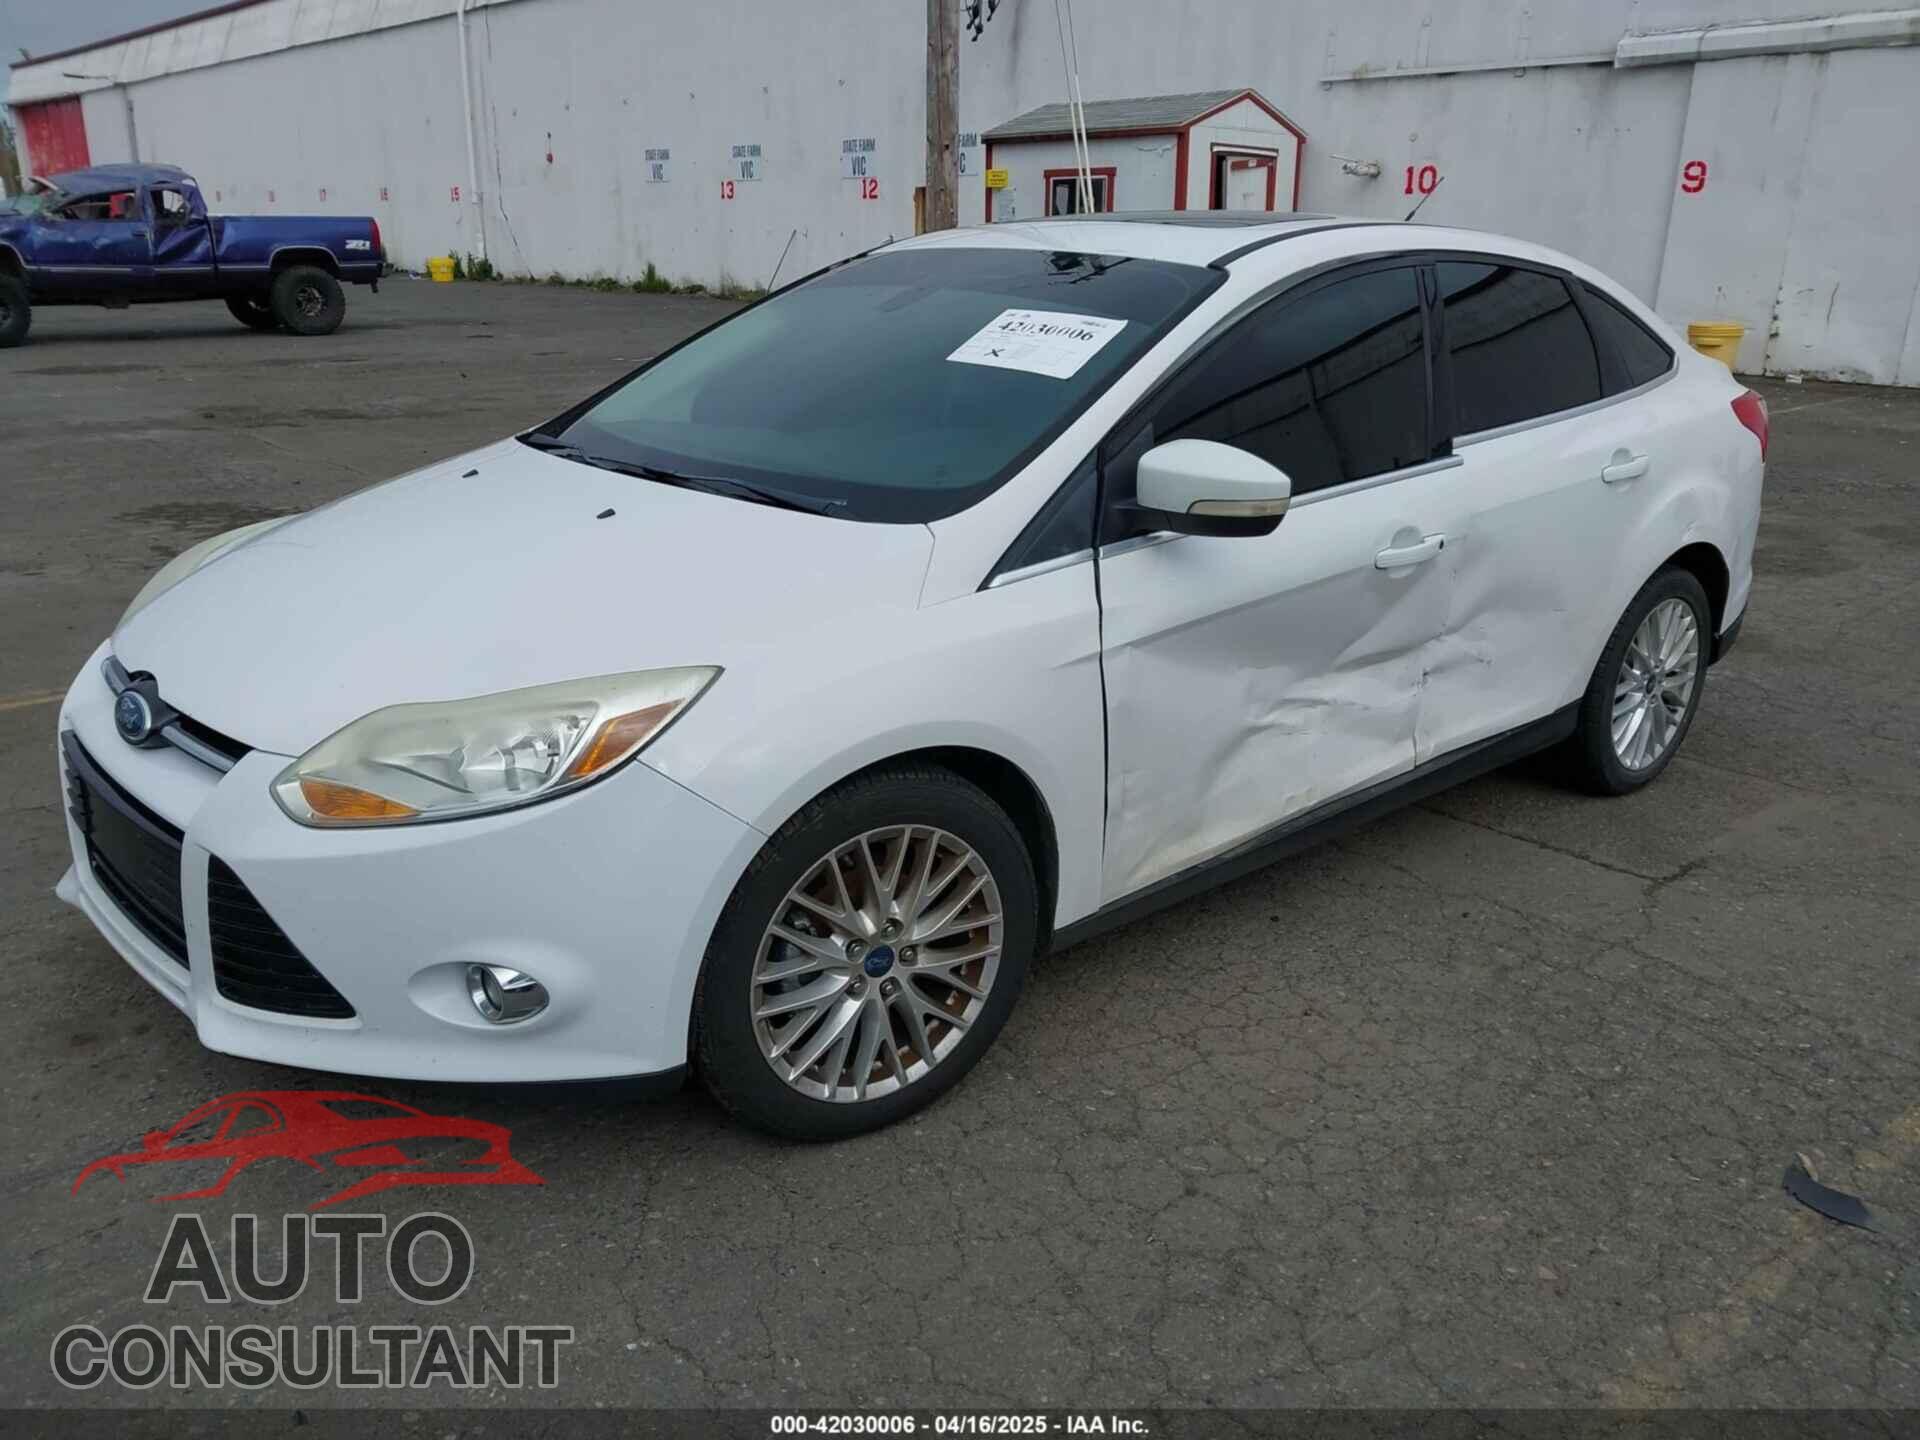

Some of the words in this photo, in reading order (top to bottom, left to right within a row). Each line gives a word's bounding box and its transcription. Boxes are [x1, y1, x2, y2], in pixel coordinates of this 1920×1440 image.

[842, 139, 858, 153] STATE
[858, 138, 876, 152] FARM
[740, 160, 754, 179] VIC
[851, 156, 866, 176] VIC
[1404, 165, 1438, 195] 10
[1681, 160, 1707, 193] 9
[721, 181, 734, 200] 13
[862, 178, 879, 199] 12
[998, 320, 1094, 341] 42030006
